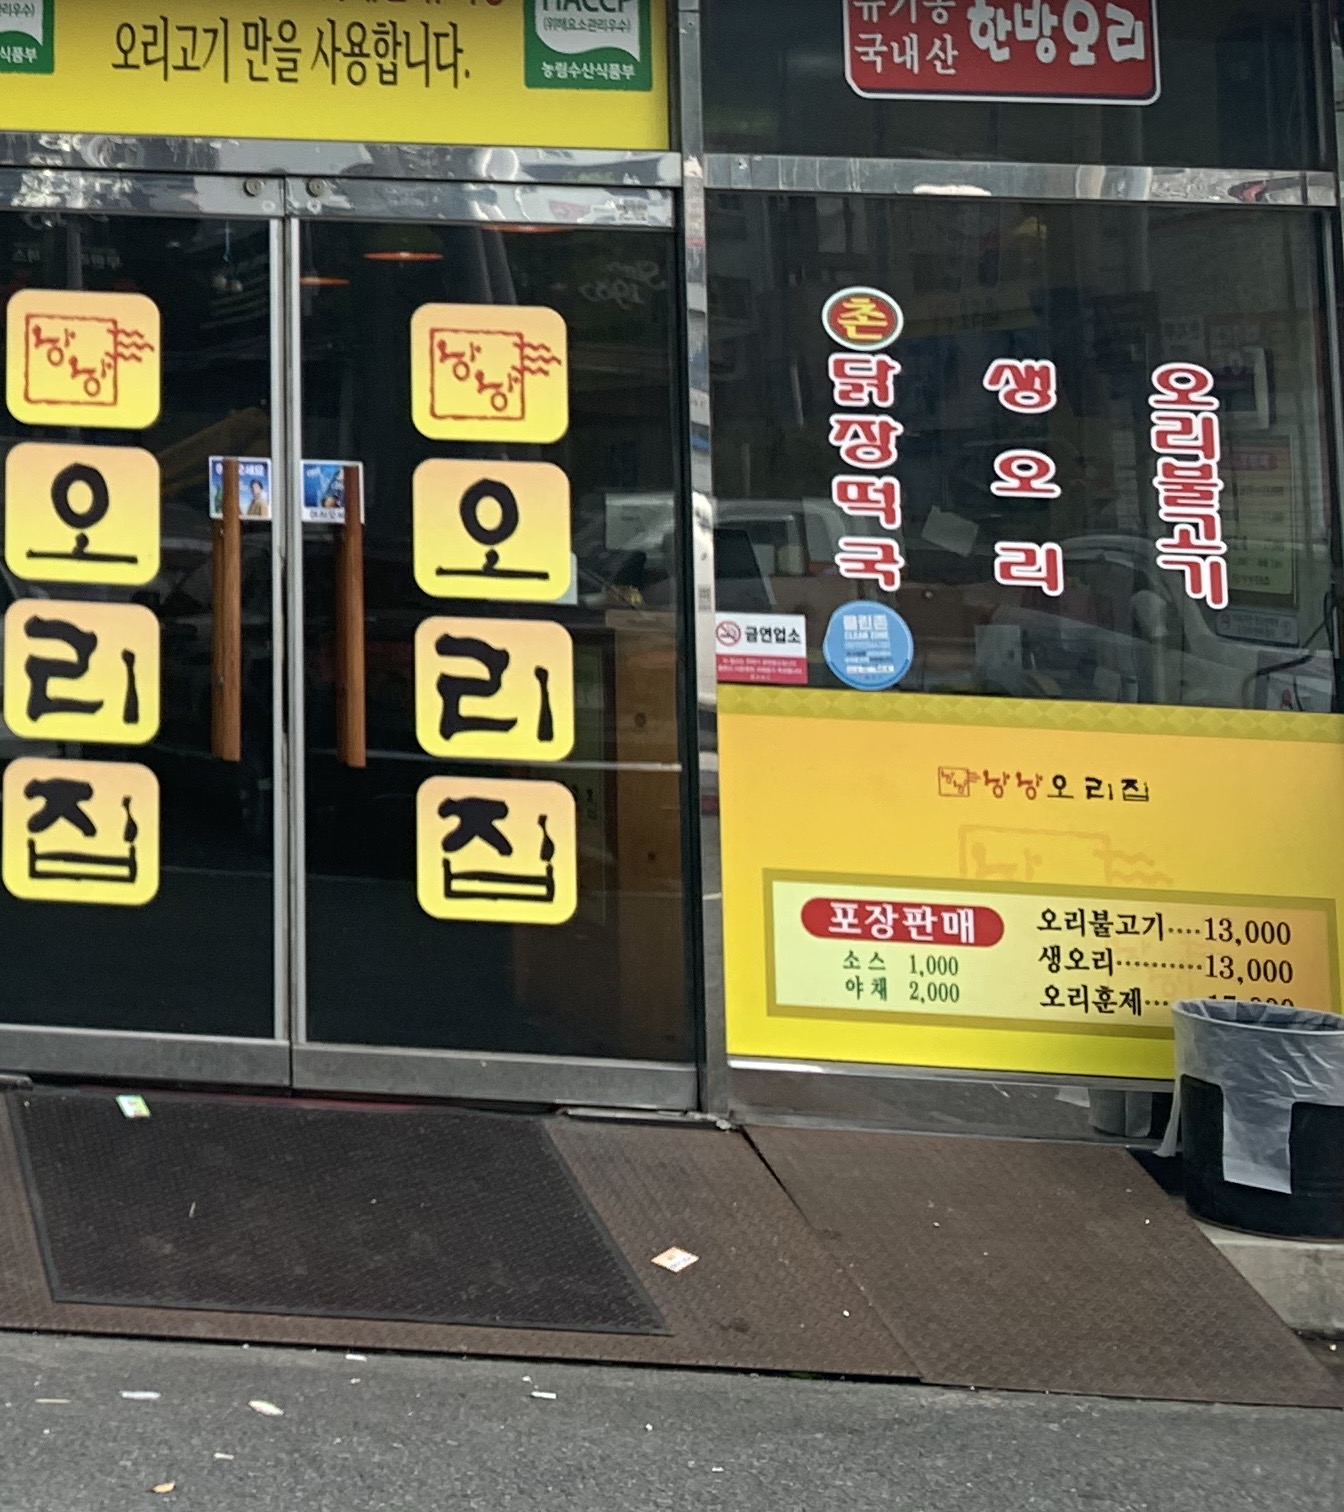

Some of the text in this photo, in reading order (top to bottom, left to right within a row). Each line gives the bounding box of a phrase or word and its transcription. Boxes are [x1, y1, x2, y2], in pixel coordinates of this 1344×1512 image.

[111, 17, 471, 88] 오리고기 만을 사용합니다.
[854, 33, 958, 76] 국내산
[540, 59, 635, 82] 농림수산식품부
[1149, 362, 1227, 610] 오리불고기
[745, 627, 801, 644] 금연업소
[827, 902, 975, 944] 포장판매
[1203, 917, 1291, 947] 13,000
[909, 954, 959, 978] 1,000
[1204, 955, 1293, 985] 13,000
[909, 980, 960, 1003] 2,000
